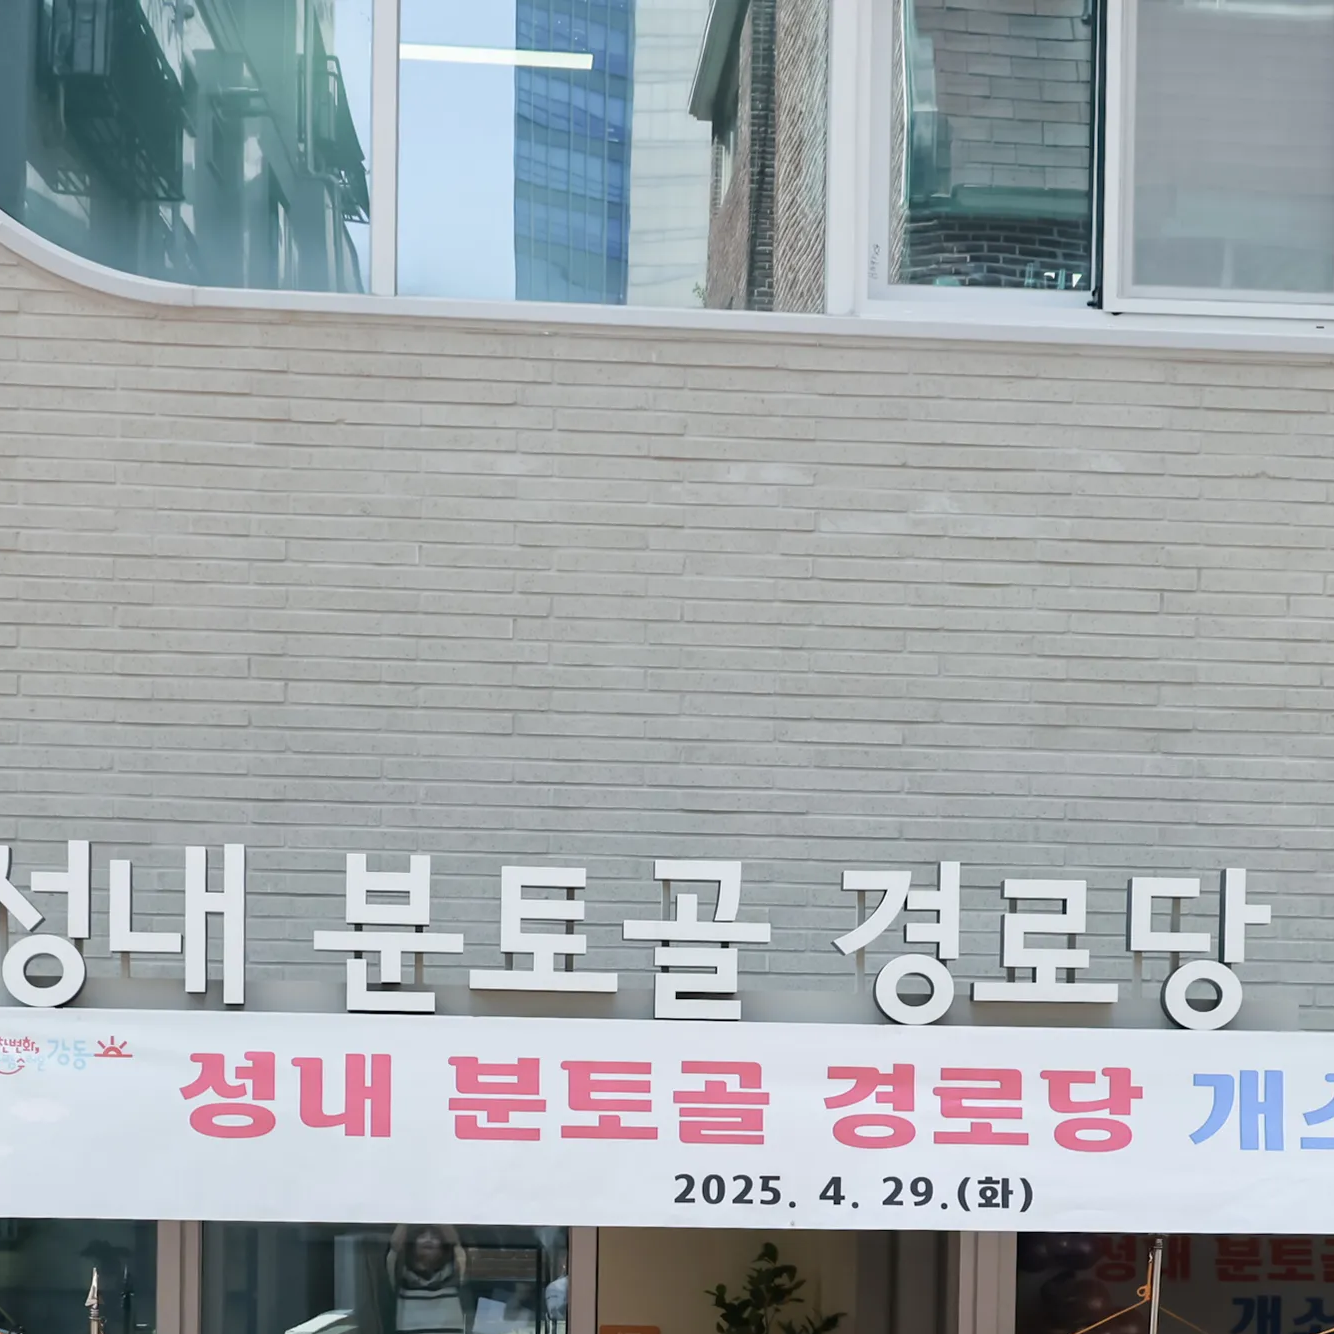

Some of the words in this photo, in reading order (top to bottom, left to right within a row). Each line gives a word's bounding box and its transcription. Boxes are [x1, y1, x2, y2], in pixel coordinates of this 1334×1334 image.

[313, 853, 771, 1020] 분토골
[833, 860, 1272, 1030] 경로당
[47, 1037, 94, 1071] 강동
[180, 1051, 392, 1139] 성내
[448, 1056, 770, 1145] 분토골
[824, 1063, 1144, 1153] 경로당
[674, 1173, 799, 1208] 2025.
[819, 1176, 860, 1209] 4.
[882, 1176, 1034, 1214] 29.(화)
